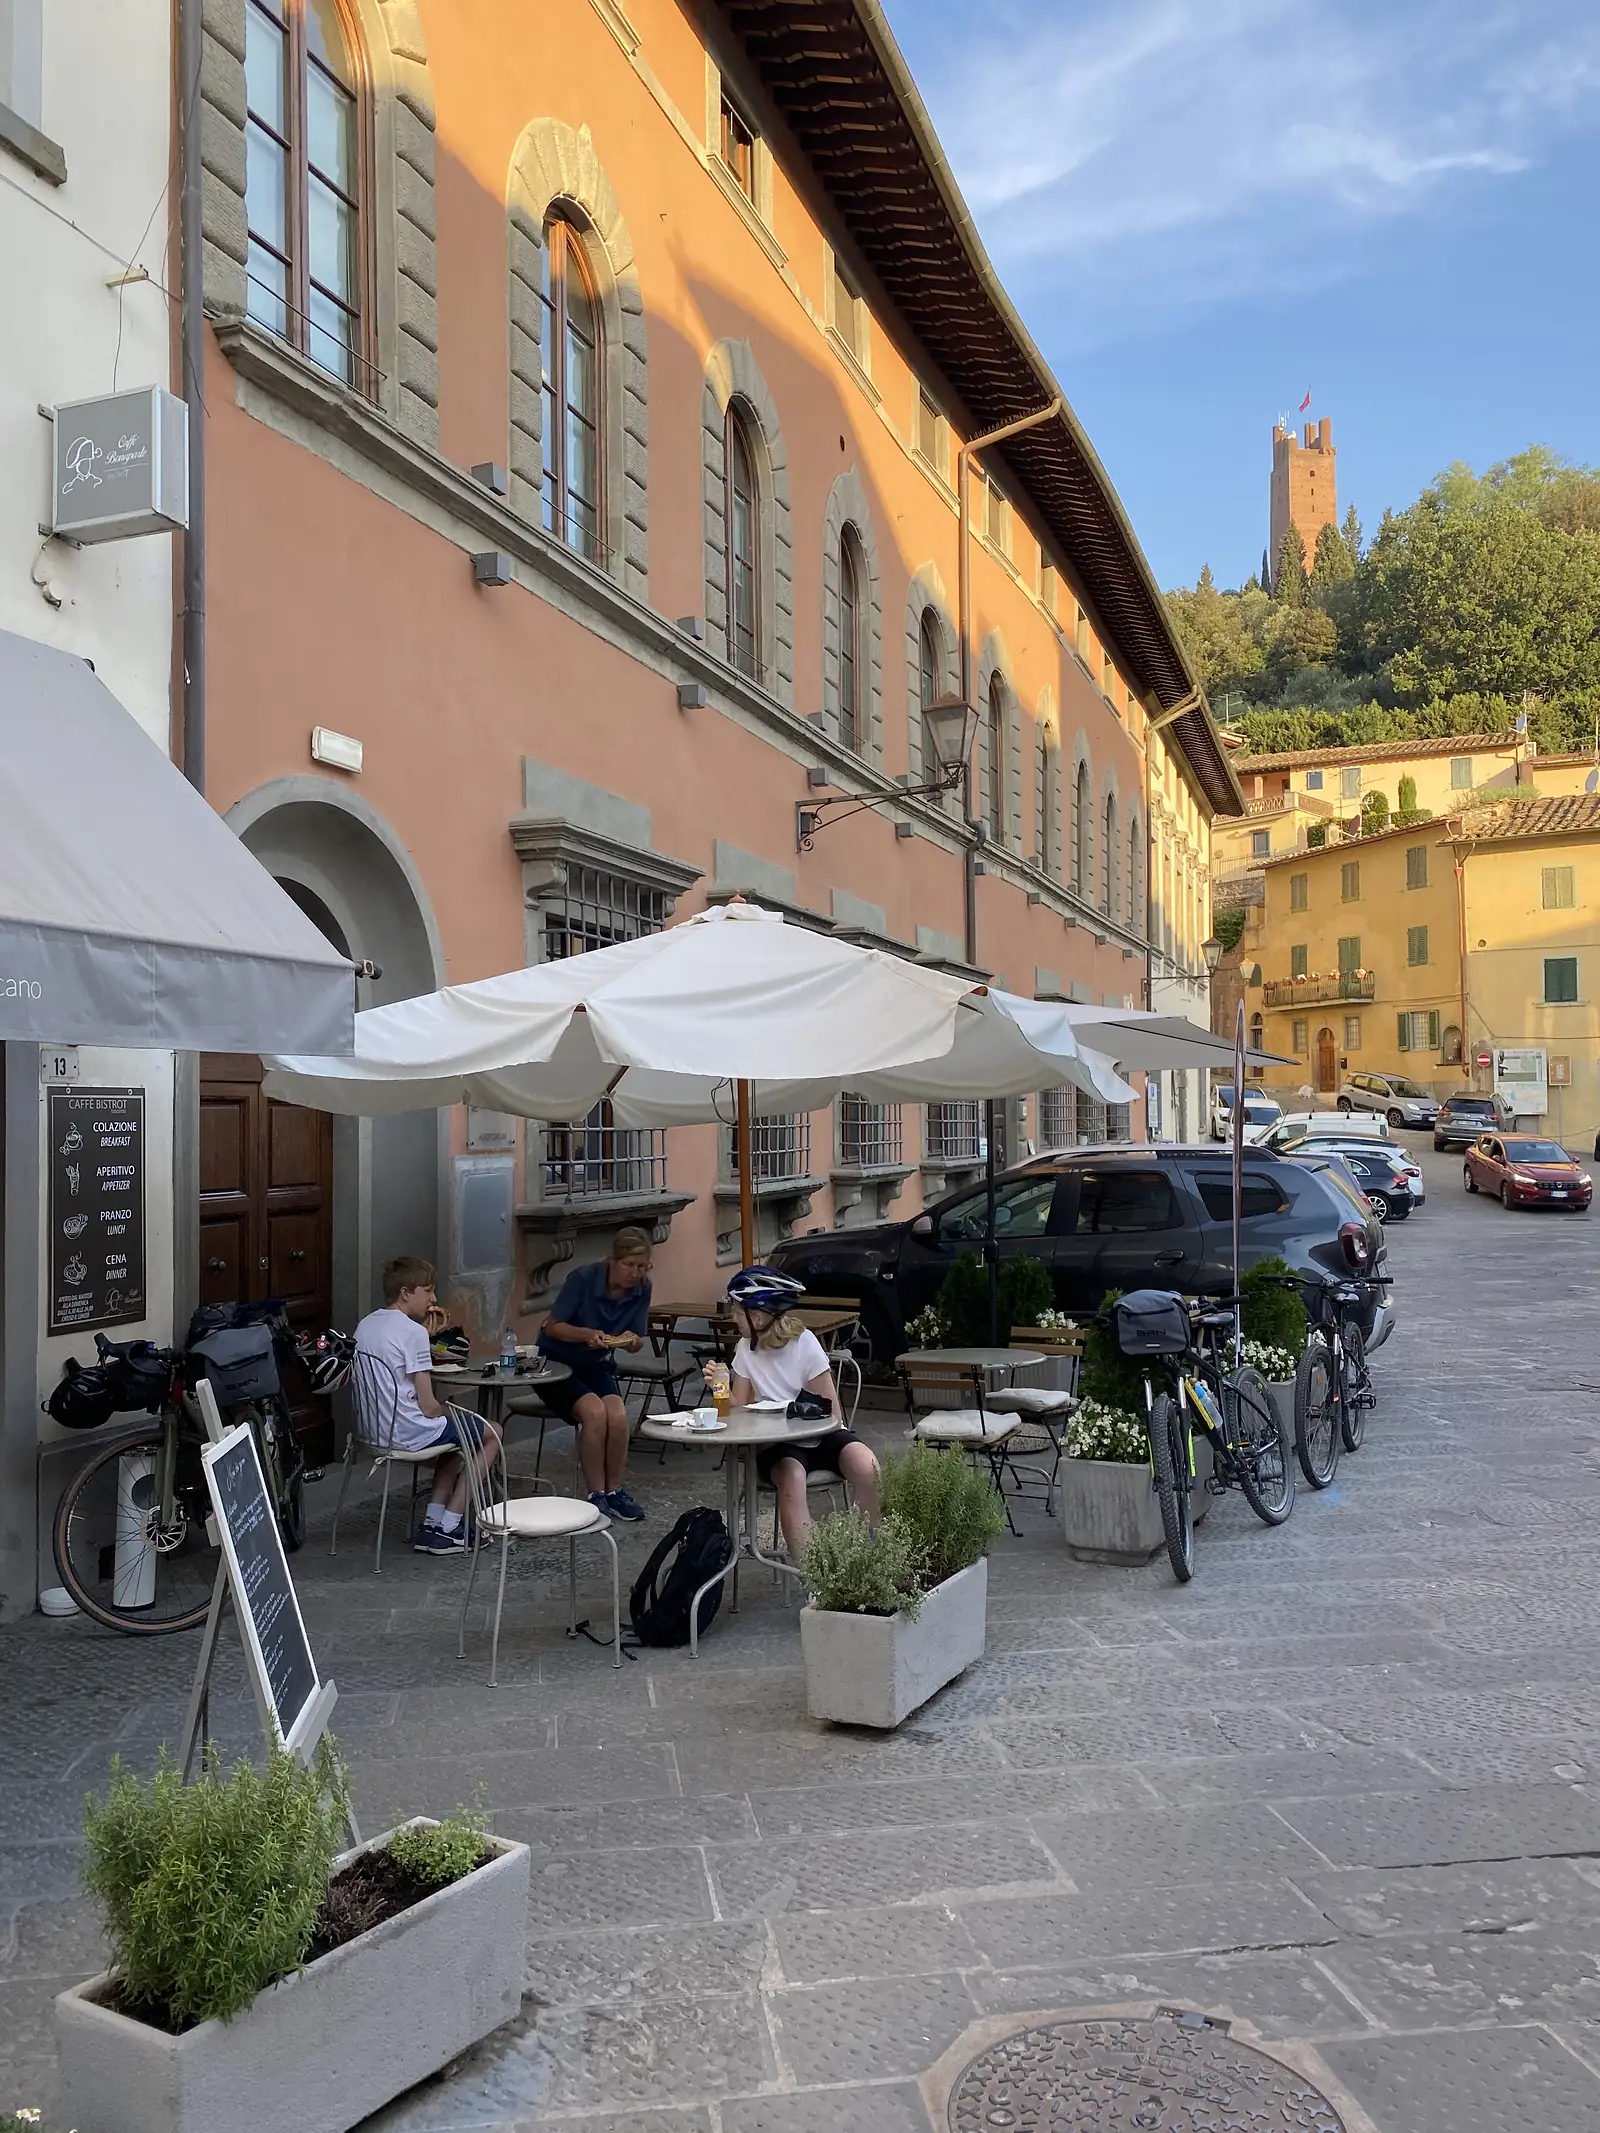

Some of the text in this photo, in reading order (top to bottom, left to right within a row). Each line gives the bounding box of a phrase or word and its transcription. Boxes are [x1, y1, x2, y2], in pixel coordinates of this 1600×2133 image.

[54, 1057, 66, 1076] 13
[68, 1097, 128, 1110] CAFFÈ BISTROT
[92, 1121, 137, 1132] COLAZIONE
[100, 1136, 131, 1147] BREAKFAST
[96, 1165, 135, 1177] APERITIVO
[101, 1180, 131, 1191] APPETIZER
[100, 1209, 132, 1221] PRANZO
[107, 1224, 126, 1236] LUNCH
[105, 1253, 127, 1265] CENA
[105, 1268, 127, 1280] DINNER
[1136, 1329, 1166, 1337] BRN
